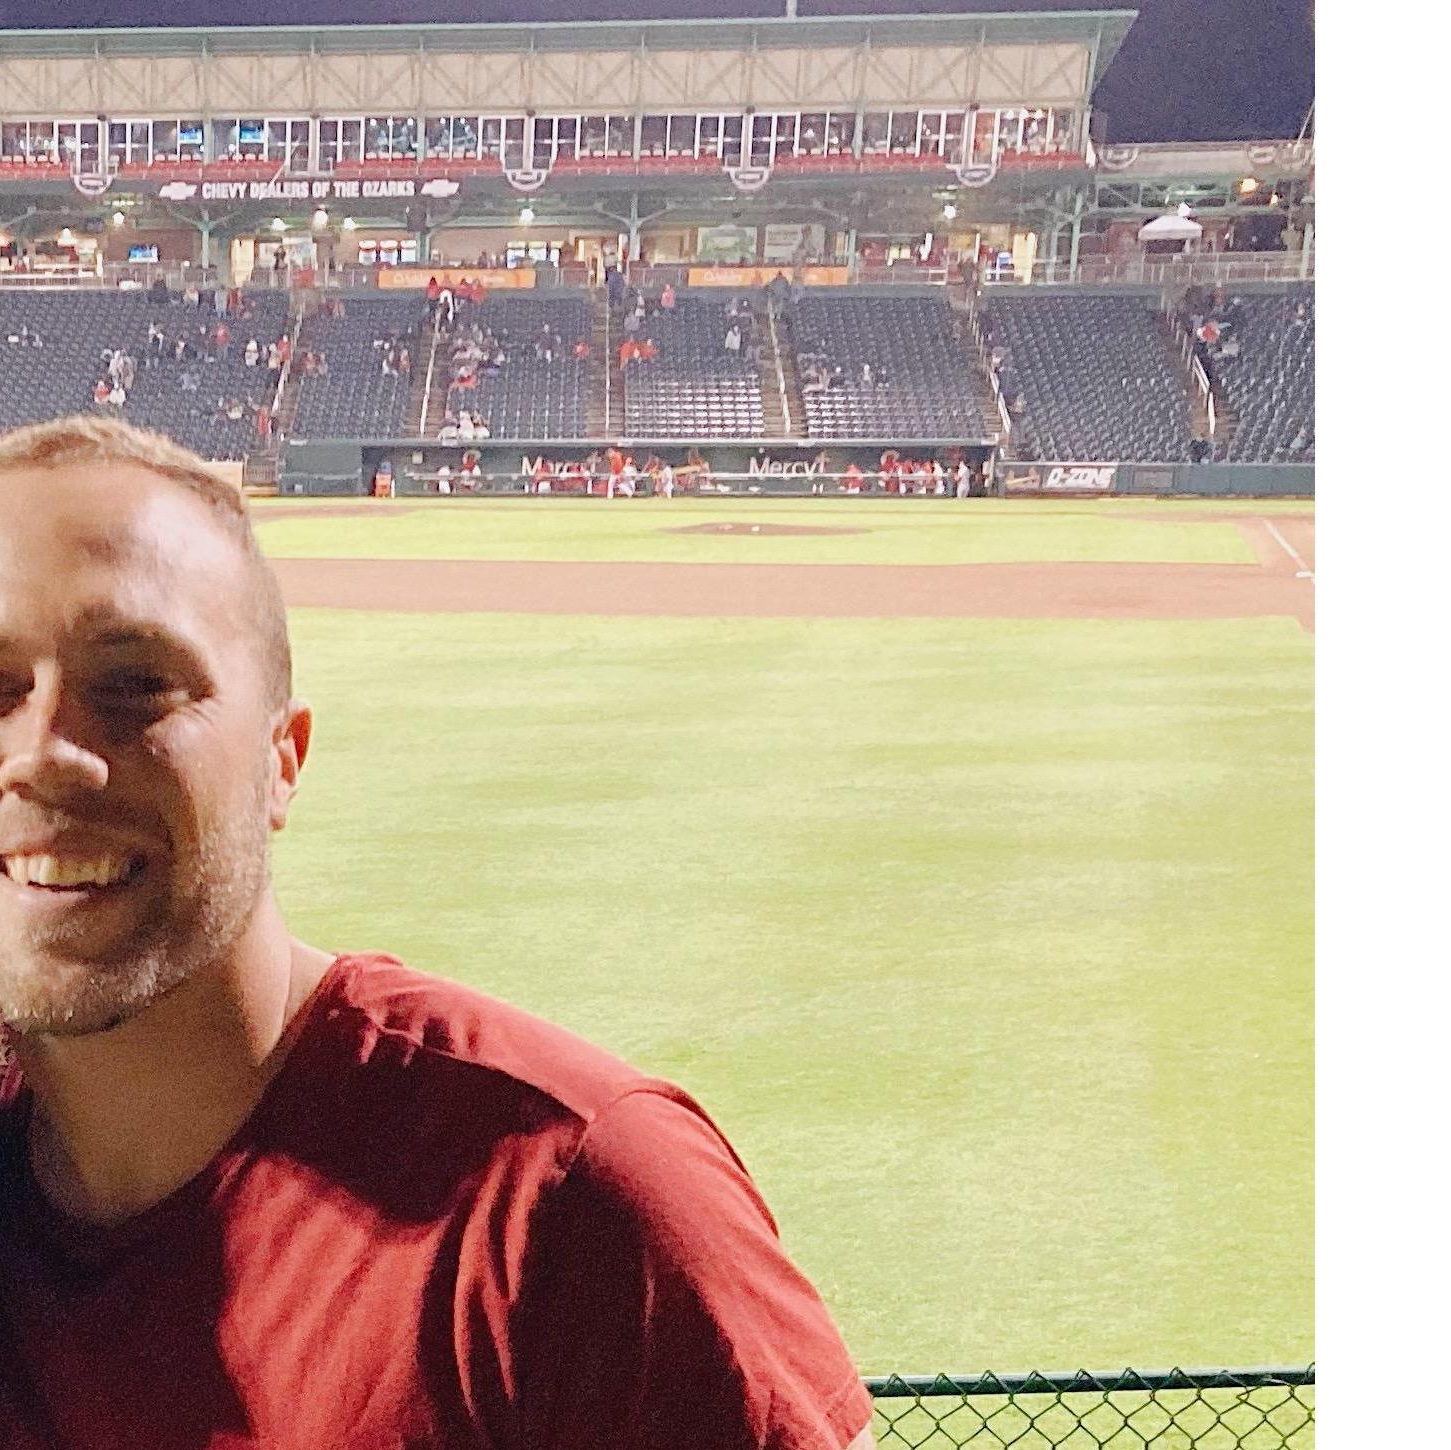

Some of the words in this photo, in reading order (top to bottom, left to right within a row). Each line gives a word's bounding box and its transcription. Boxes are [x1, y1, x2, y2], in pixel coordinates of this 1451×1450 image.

[201, 182, 247, 199] CHEVY
[250, 182, 309, 199] DEALERS
[312, 182, 329, 198] OF
[334, 181, 359, 197] THE
[362, 181, 415, 196] OZARKS
[522, 456, 590, 476] Mrcy
[750, 456, 820, 480] Mercy
